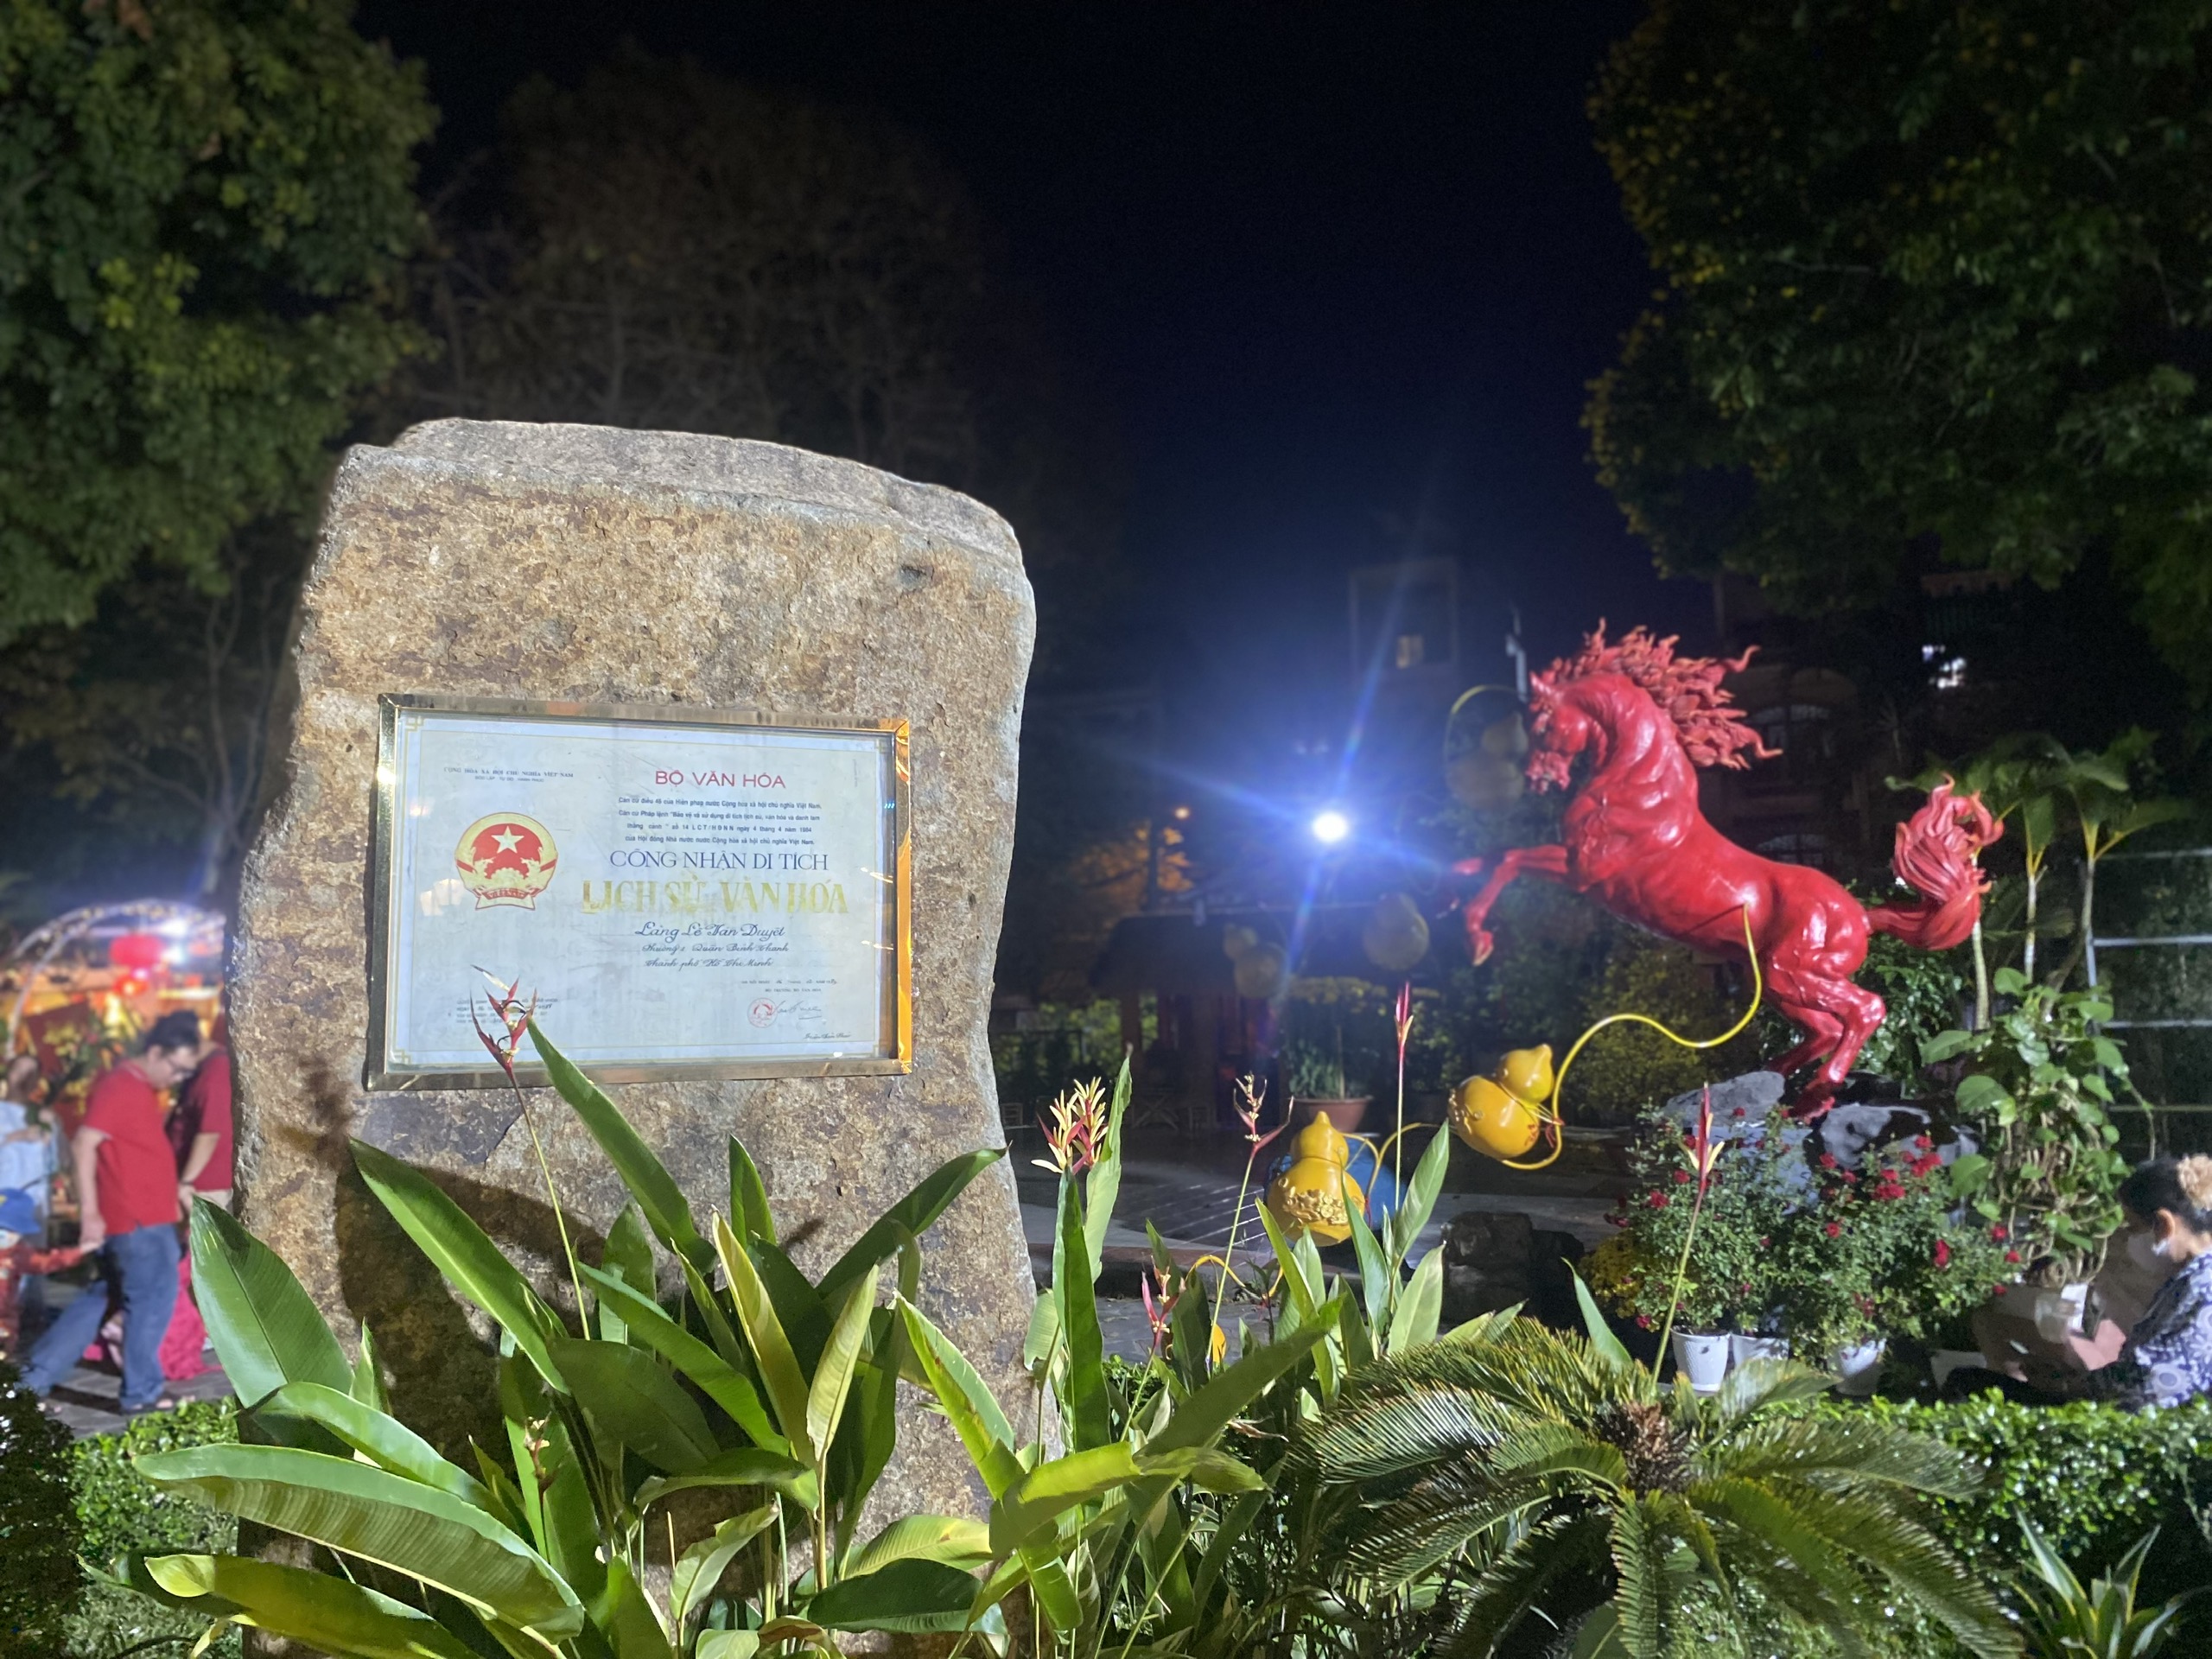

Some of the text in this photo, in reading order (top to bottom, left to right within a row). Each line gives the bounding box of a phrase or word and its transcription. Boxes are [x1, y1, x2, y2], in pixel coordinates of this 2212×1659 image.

[655, 769, 786, 788] BỘ VĂN HÓA
[609, 848, 830, 871] CÔNG NHẬN DI TÍCH
[719, 874, 781, 914] VĂN
[787, 878, 849, 914] HÓA
